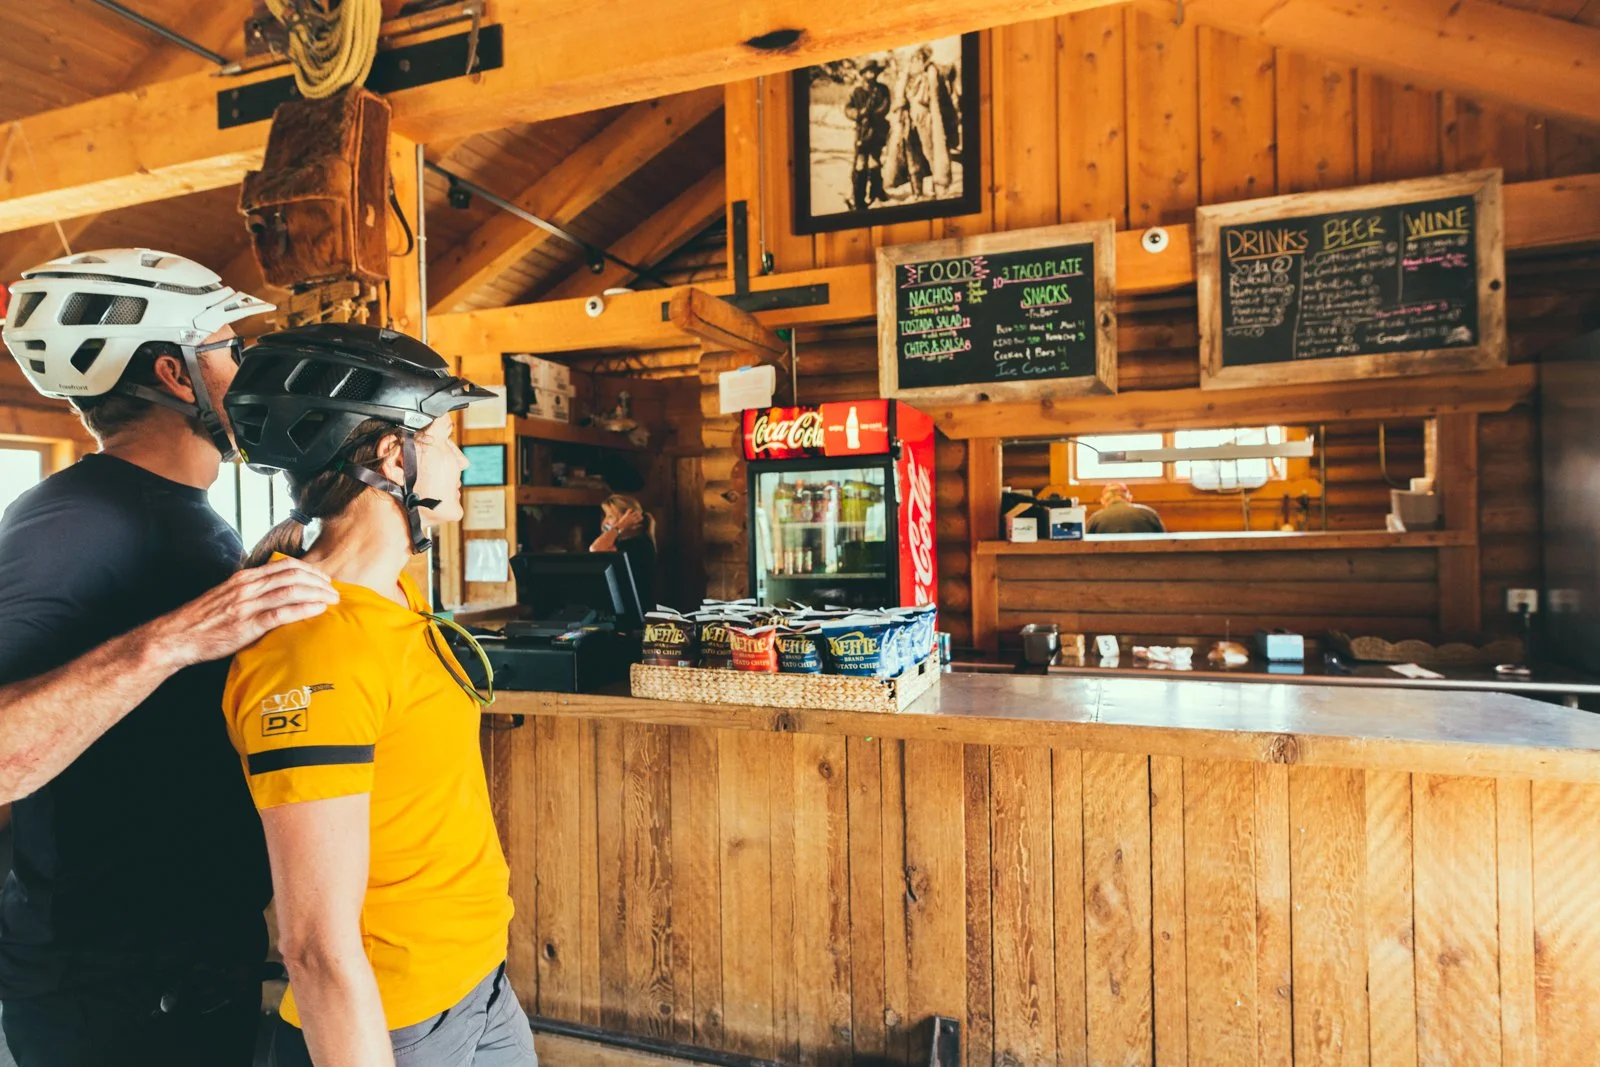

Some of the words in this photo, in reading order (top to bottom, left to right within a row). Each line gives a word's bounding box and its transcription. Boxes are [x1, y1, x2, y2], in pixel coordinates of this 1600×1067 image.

[1405, 206, 1471, 236] WINE
[1226, 228, 1309, 258] DRINKS
[1324, 216, 1386, 250] BEER
[917, 259, 974, 283] FOOD
[1002, 266, 1009, 280] 3
[1012, 262, 1042, 280] TACO
[1045, 257, 1083, 276] PLATE
[1230, 260, 1269, 276] Soda
[992, 276, 1004, 289] 10
[909, 286, 953, 307] NACHOS
[1023, 284, 1070, 307] SNACKS
[899, 317, 934, 333] TOSTADA
[936, 314, 962, 329] SALAD
[904, 341, 929, 357] CHIPS
[931, 340, 940, 353] &
[940, 337, 964, 351] SALSA
[995, 361, 1018, 377] Ice
[1022, 361, 1057, 374] Cream
[1060, 361, 1070, 371] 2
[643, 622, 686, 643] KETTLE
[827, 630, 881, 656] KETTLE
